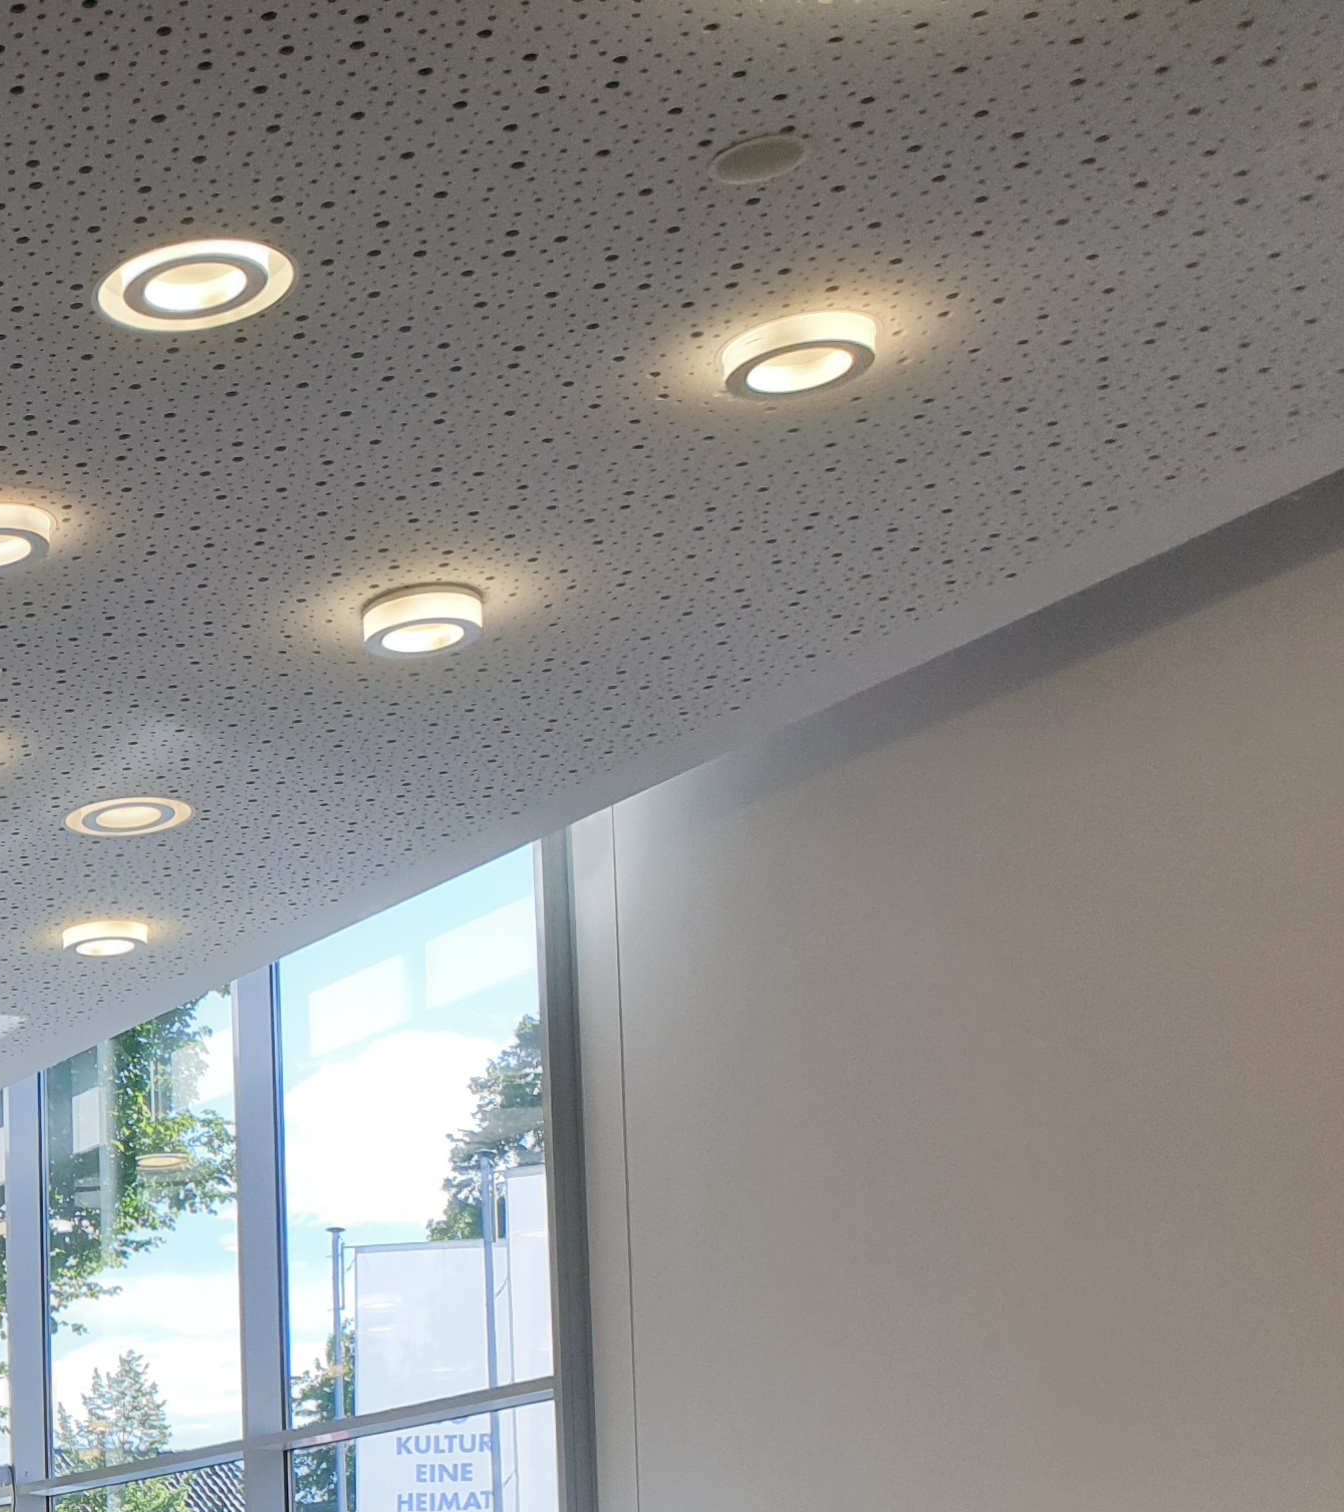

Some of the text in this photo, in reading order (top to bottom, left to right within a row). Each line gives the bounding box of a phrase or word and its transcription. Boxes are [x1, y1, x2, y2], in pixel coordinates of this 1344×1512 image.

[396, 1433, 492, 1455] KULTUR
[416, 1462, 473, 1483] EINE
[397, 1490, 493, 1512] HEIMAT
